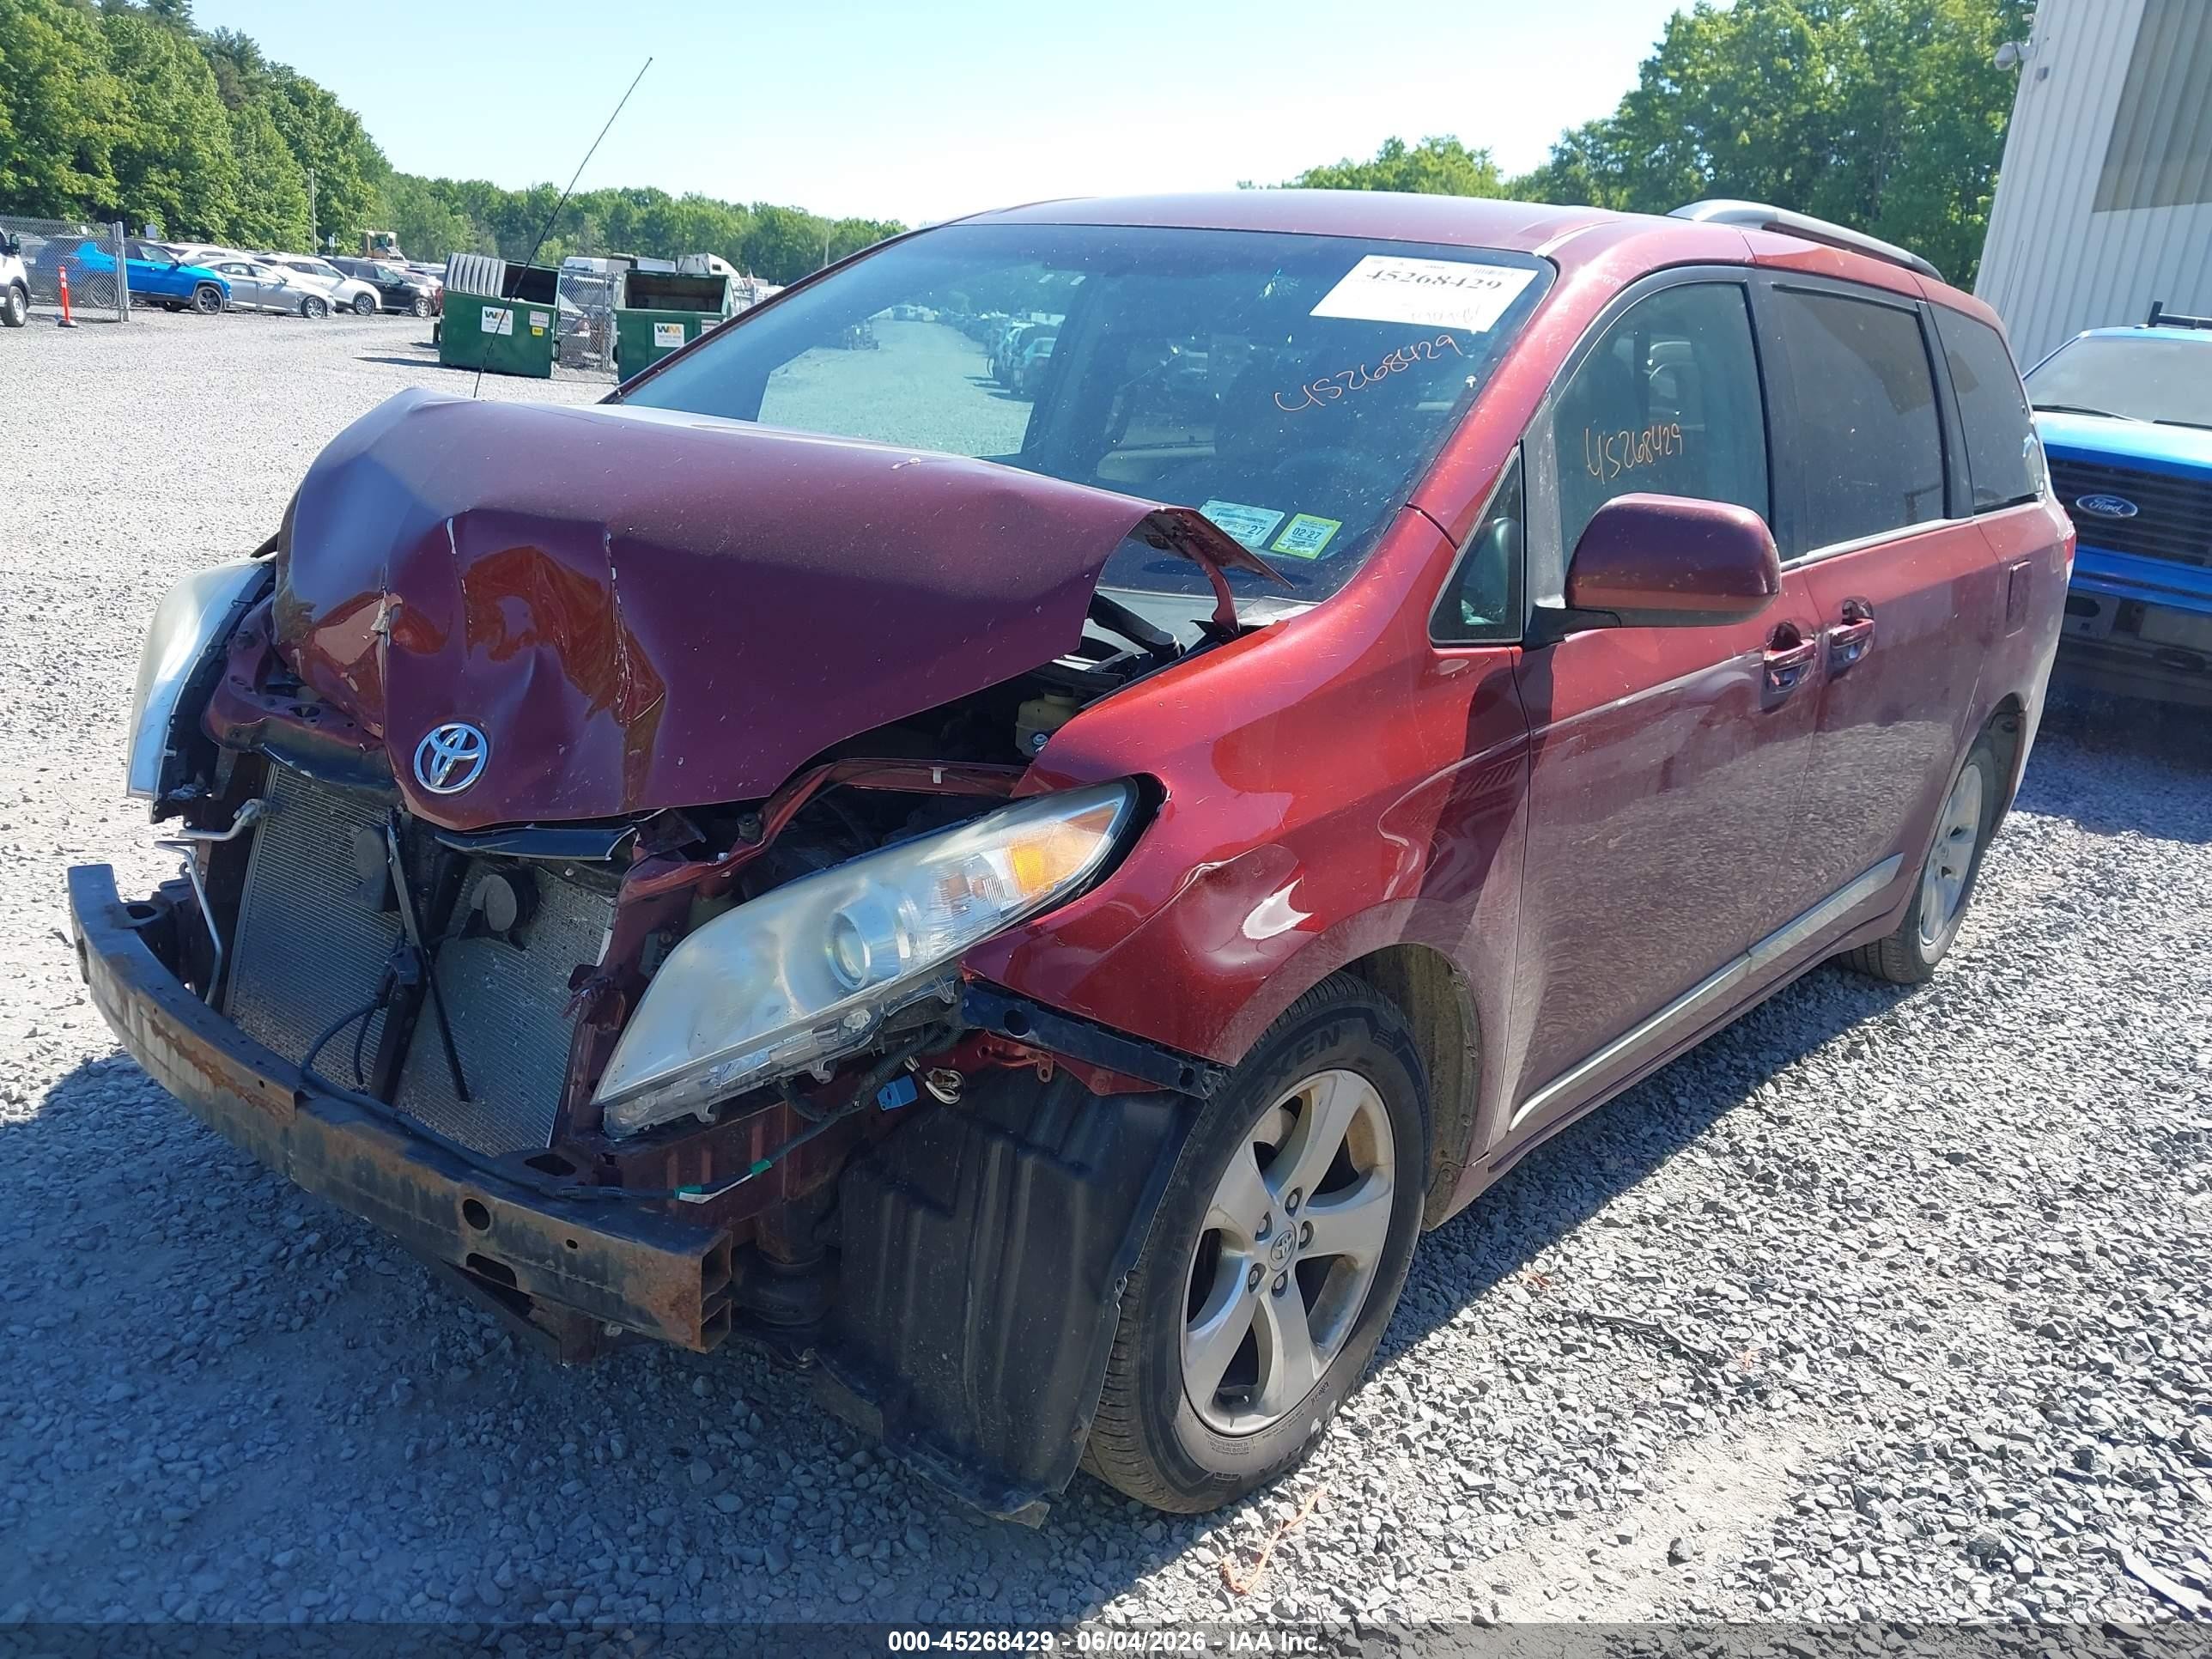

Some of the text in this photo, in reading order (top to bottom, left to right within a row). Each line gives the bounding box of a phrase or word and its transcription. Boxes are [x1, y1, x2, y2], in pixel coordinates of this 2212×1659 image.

[1365, 268, 1504, 290] 45268429
[484, 310, 508, 321] WM
[656, 325, 680, 334] WM
[1274, 334, 1463, 412] 45268429
[1585, 422, 1683, 485] 45268429
[2089, 497, 2124, 515] Ford
[1247, 525, 1267, 536] 27
